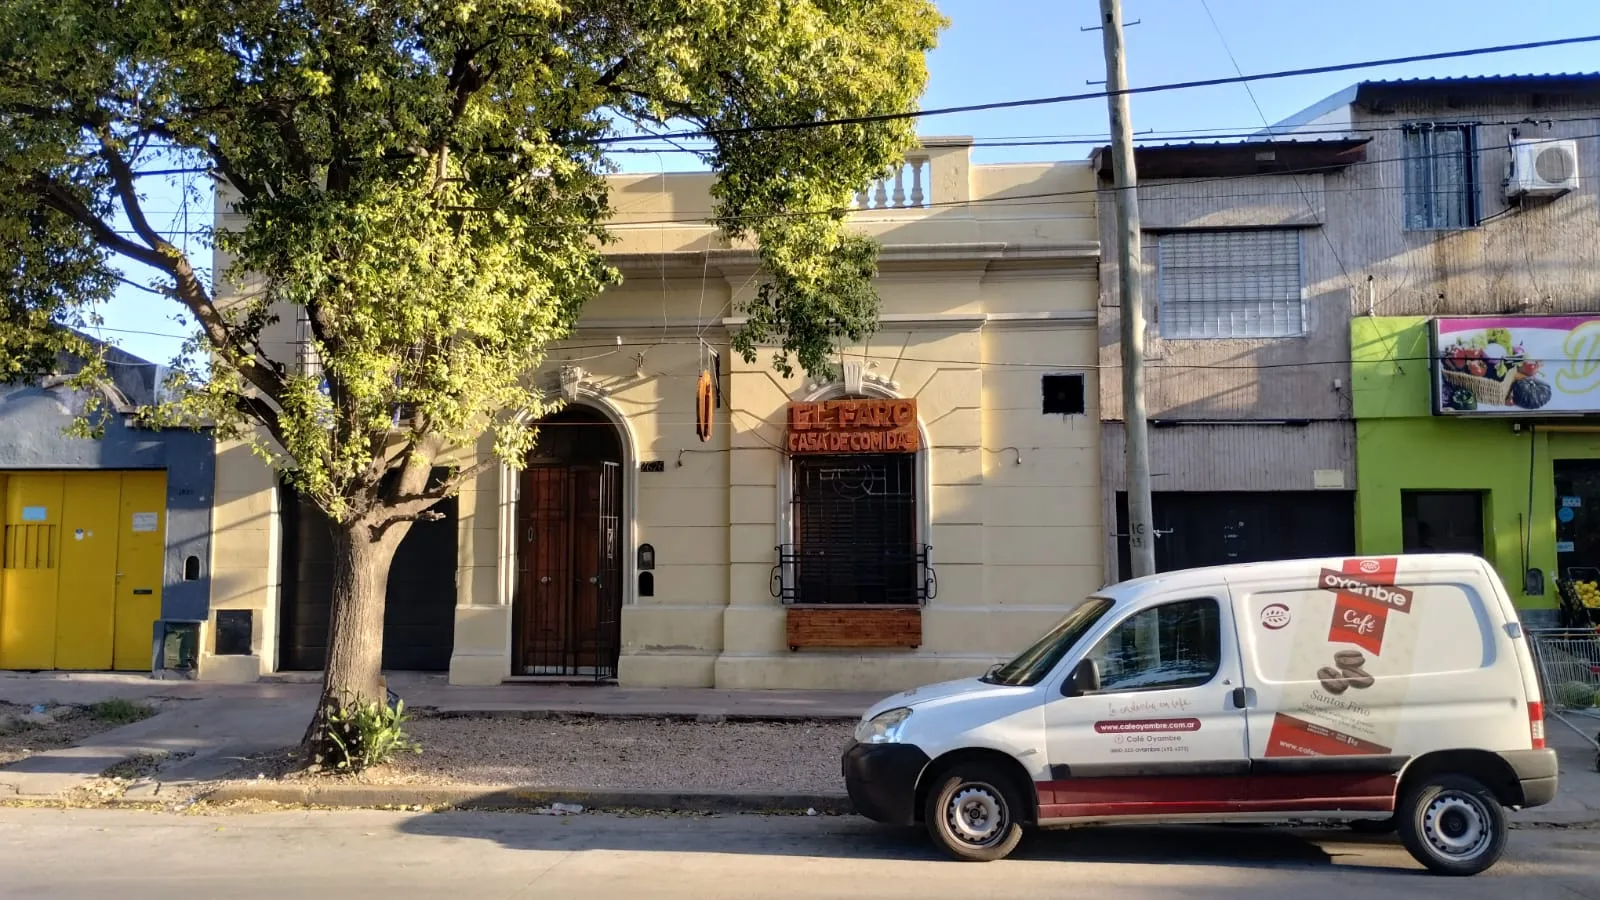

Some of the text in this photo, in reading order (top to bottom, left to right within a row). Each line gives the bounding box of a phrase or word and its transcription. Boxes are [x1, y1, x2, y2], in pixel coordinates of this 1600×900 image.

[792, 401, 914, 430] EL FARO
[789, 431, 828, 451] CASA
[830, 431, 849, 451] DE
[1325, 574, 1406, 606] oyambre
[1343, 609, 1375, 634] Café
[1310, 689, 1345, 709] Santos
[1347, 701, 1371, 716] Fino
[1147, 735, 1182, 743] Oyambre
